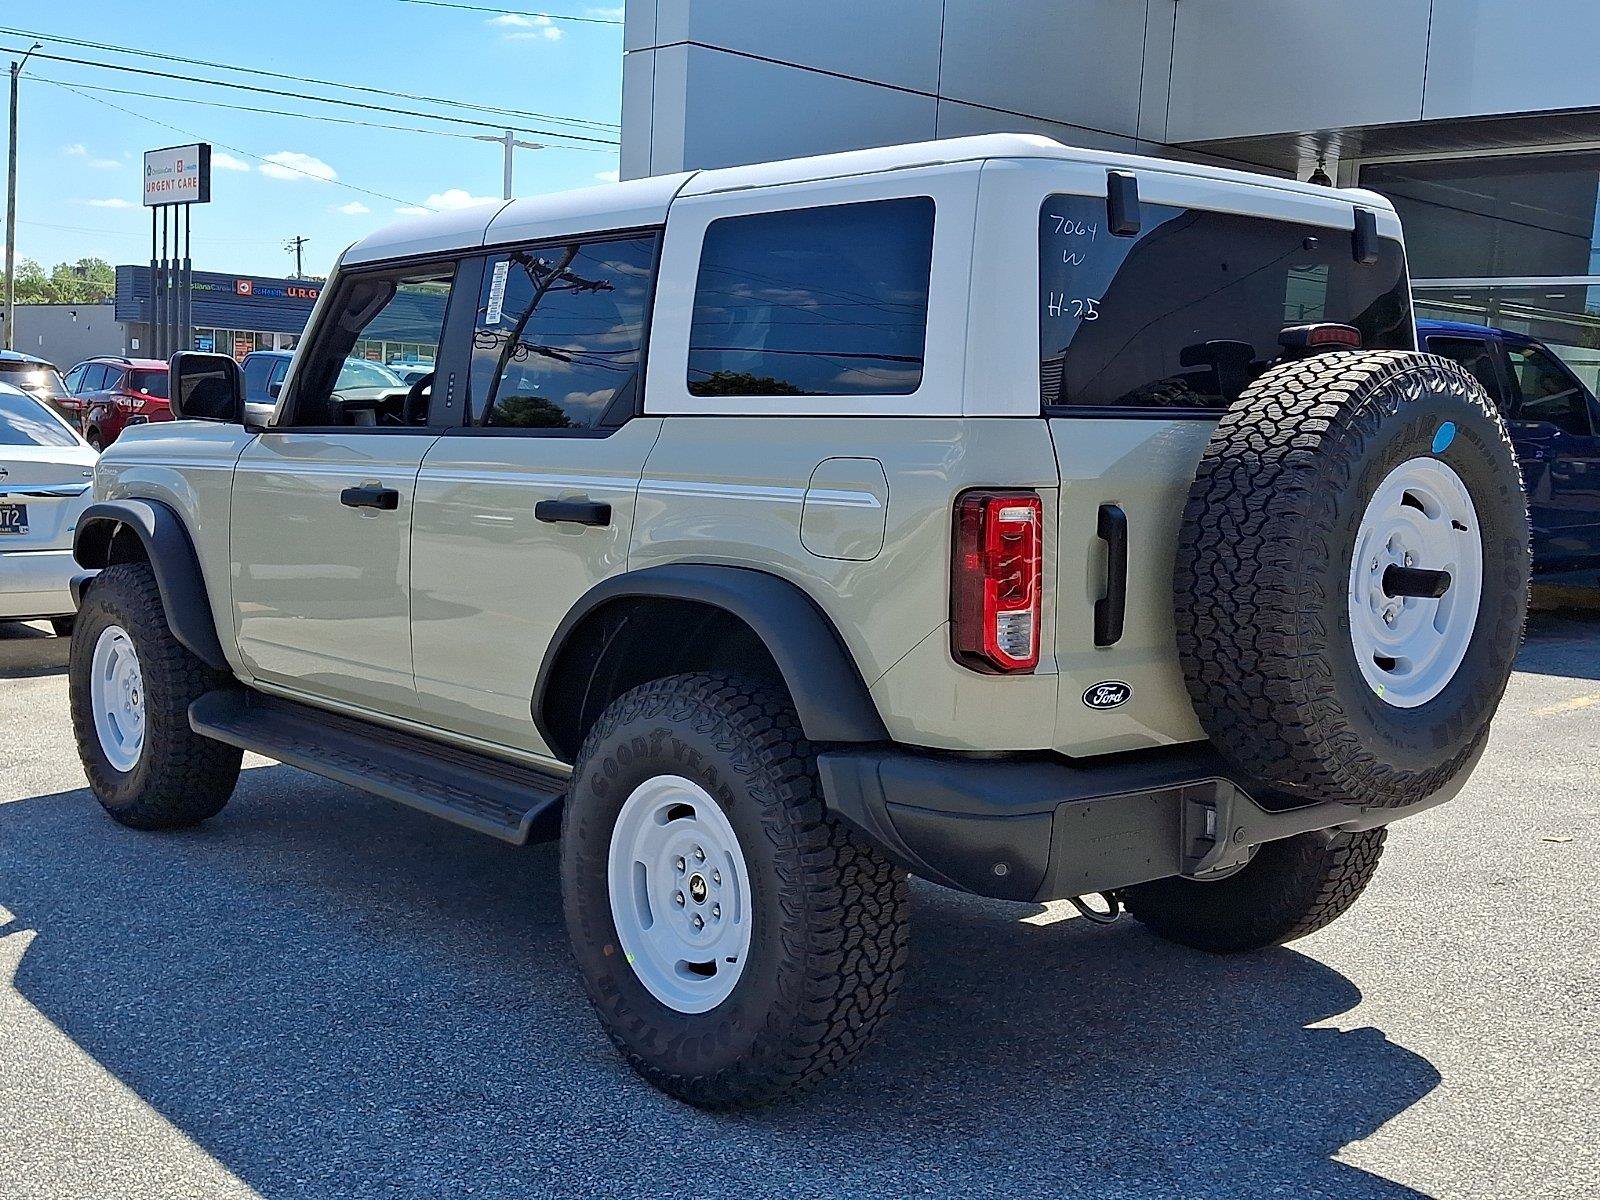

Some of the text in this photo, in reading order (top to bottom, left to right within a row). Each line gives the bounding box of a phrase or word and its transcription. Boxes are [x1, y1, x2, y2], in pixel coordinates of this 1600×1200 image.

[146, 177, 197, 193] URGENT CARE
[1049, 214, 1098, 243] 7064
[287, 287, 317, 299] URG
[1092, 686, 1125, 705] Ford
